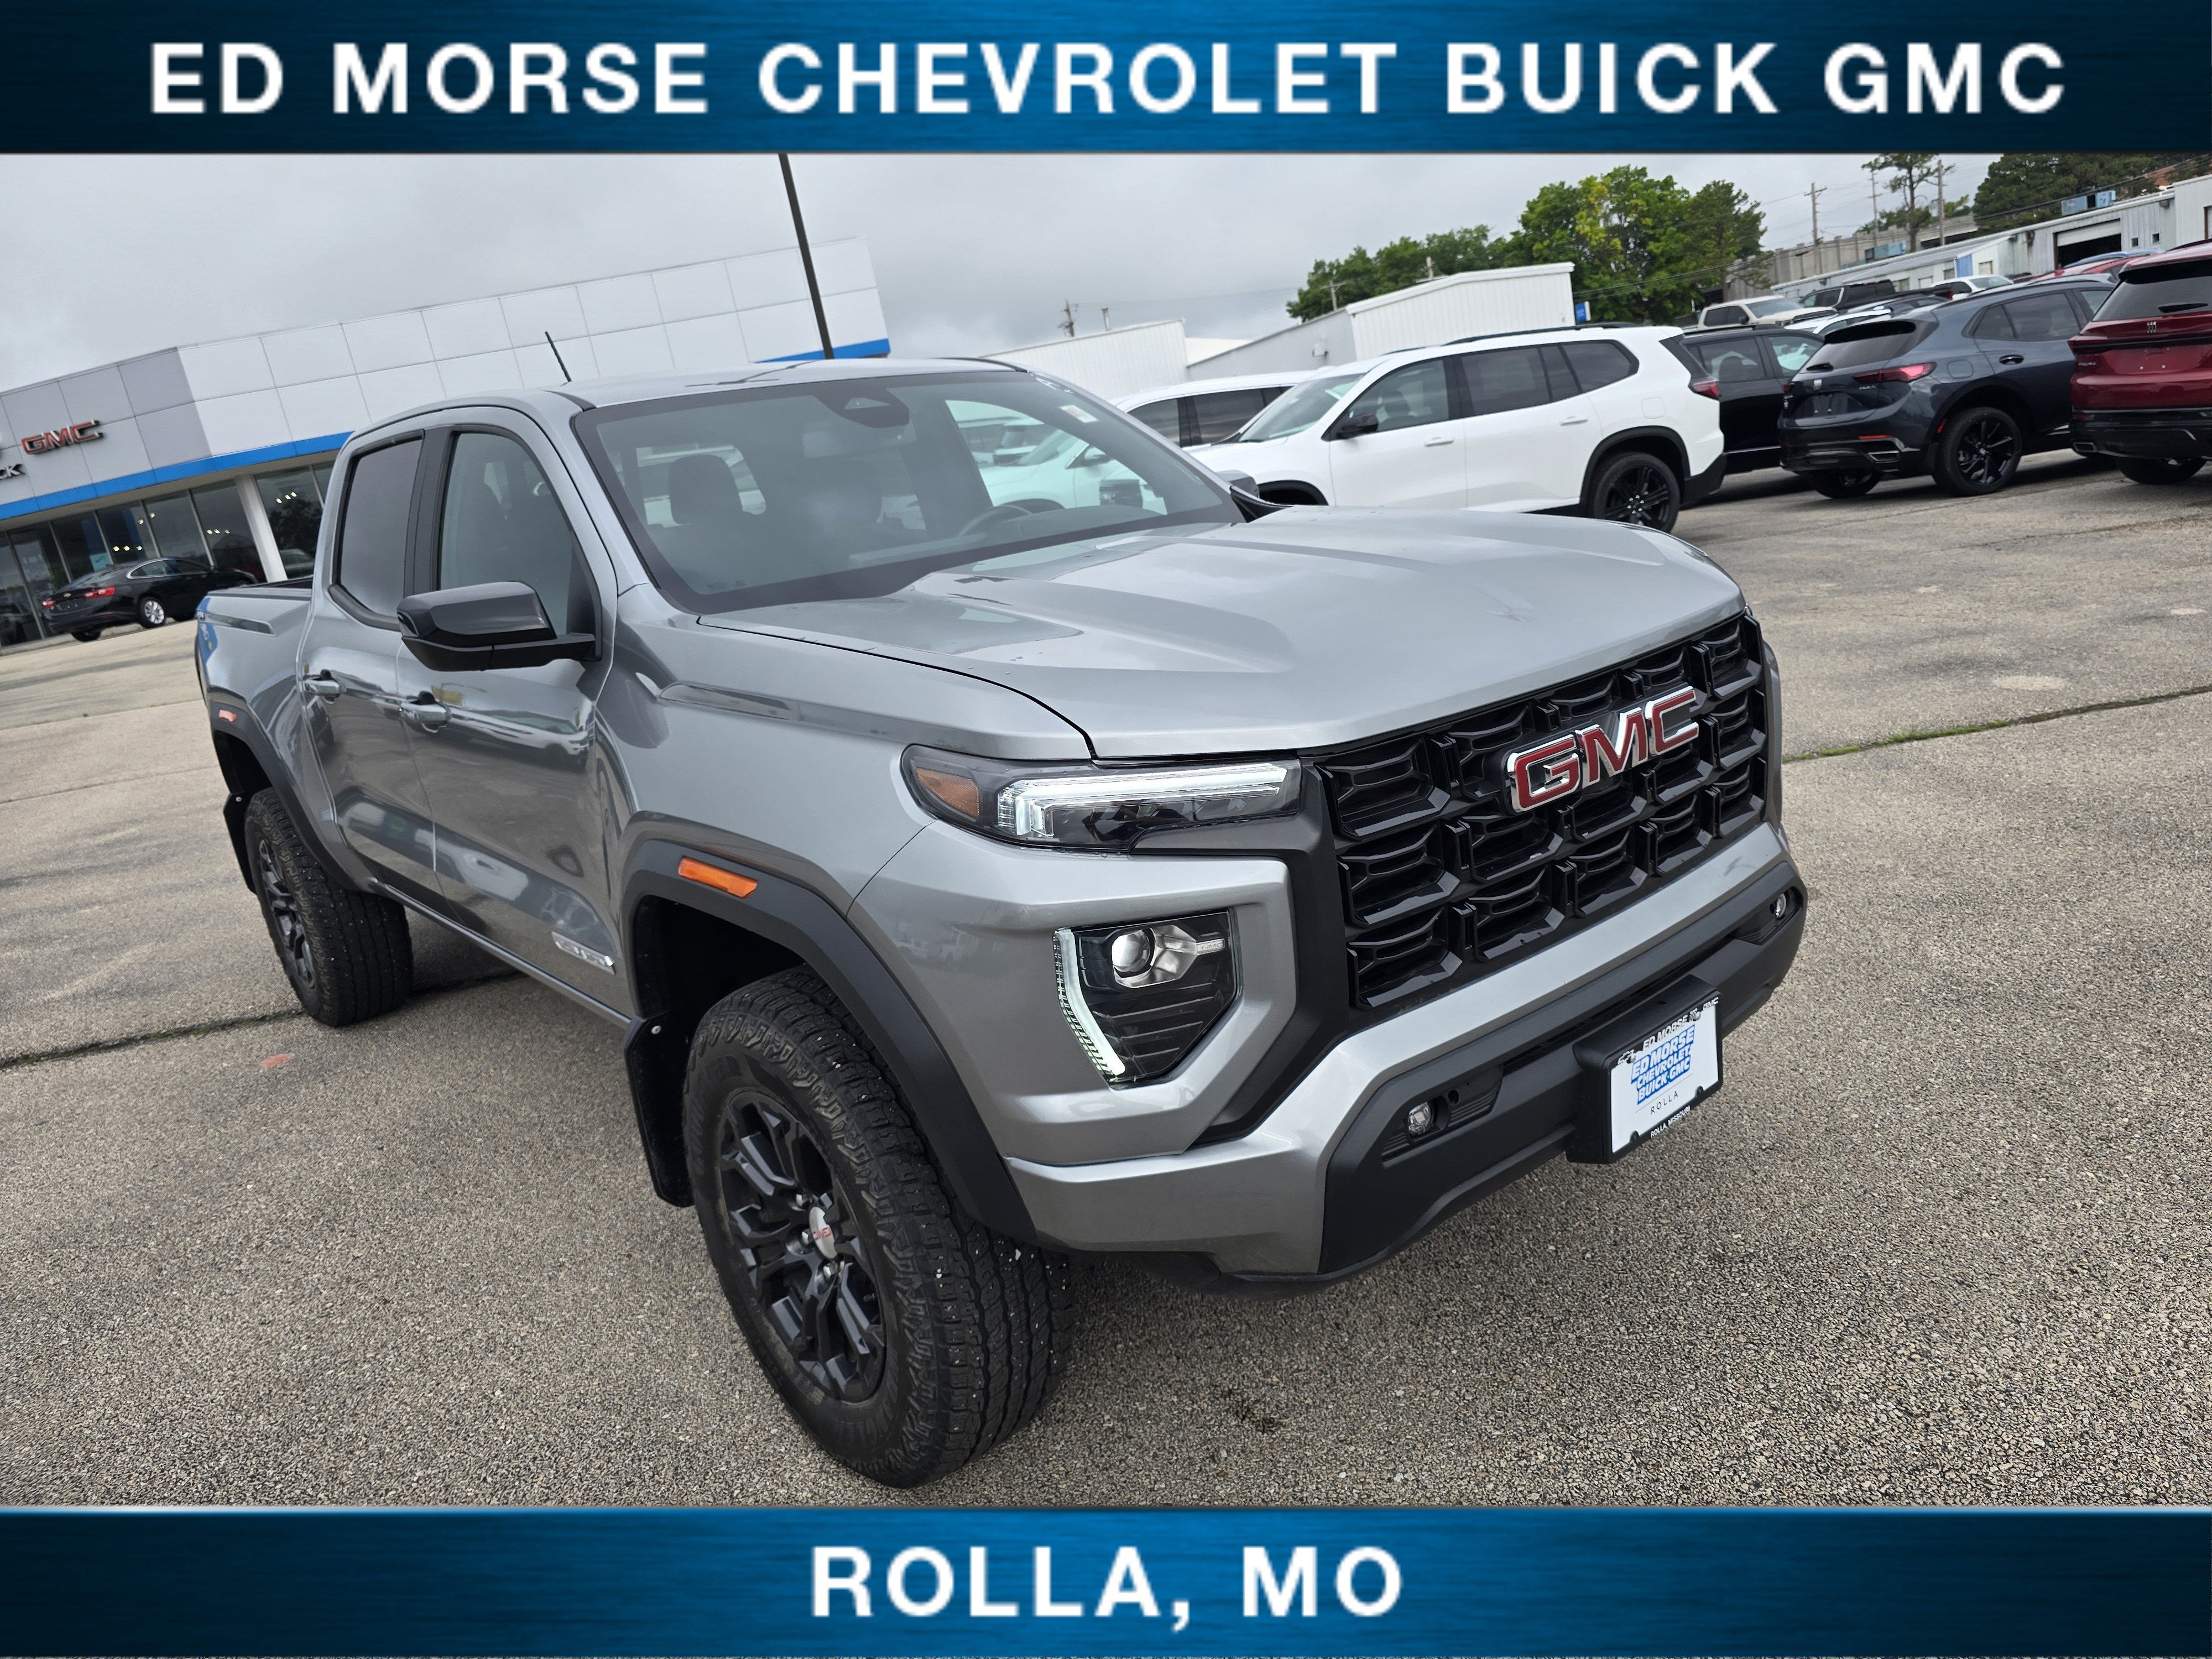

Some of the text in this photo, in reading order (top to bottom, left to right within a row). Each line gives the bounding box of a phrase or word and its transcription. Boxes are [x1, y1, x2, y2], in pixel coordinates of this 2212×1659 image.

[22, 420, 101, 455] GMC
[1506, 686, 1699, 812] GMC
[1631, 1025, 1694, 1081] ED MORSE
[1637, 1044, 1691, 1089] CHEVROLET
[1638, 1056, 1691, 1102] BUICK GMC
[1651, 1091, 1678, 1115] ROLLA
